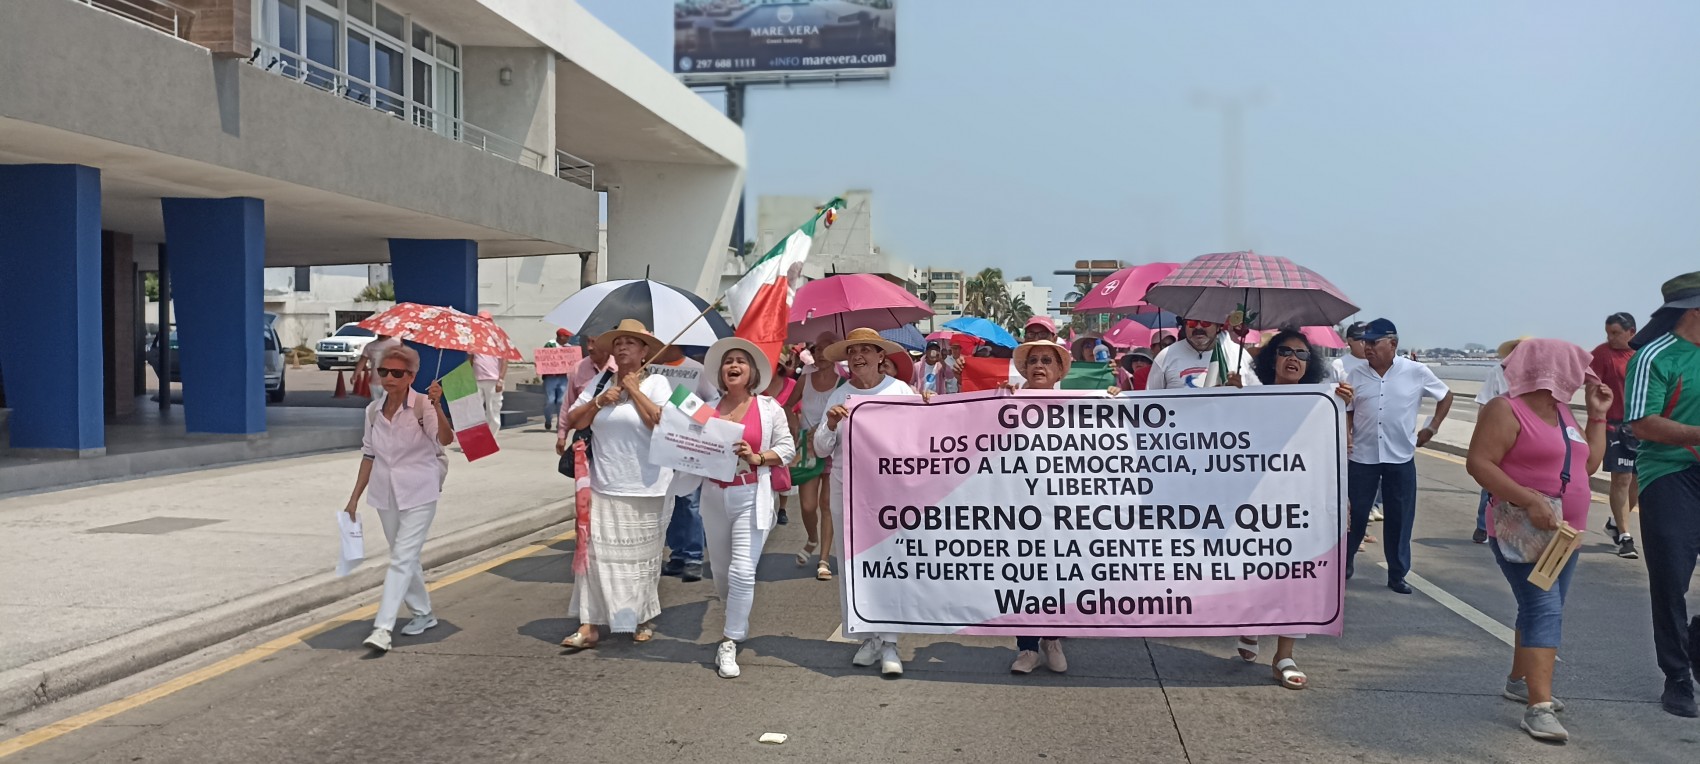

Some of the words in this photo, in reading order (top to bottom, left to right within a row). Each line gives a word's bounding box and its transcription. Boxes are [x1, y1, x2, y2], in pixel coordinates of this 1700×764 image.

[750, 27, 784, 37] MARE
[788, 25, 819, 36] VERA
[696, 59, 712, 69] 297
[734, 58, 756, 68] 1111
[802, 54, 887, 66] marevera.com
[998, 404, 1175, 428] GOBIERNO:
[930, 436, 968, 453] LOS
[975, 434, 1128, 451] CIUDADANOS
[1137, 432, 1250, 450] EXIGIMOS
[879, 457, 970, 475] RESPETO
[978, 457, 993, 474] A
[1001, 457, 1028, 473] LA
[1037, 455, 1196, 475] DEMOCRACIA,
[1205, 454, 1306, 472] JUSTICIA
[1025, 478, 1038, 495] Y
[1047, 478, 1153, 495] LIBERTAD
[878, 505, 1041, 530] GOBIERNO
[1054, 505, 1224, 530] RECUERDA
[1235, 504, 1308, 532] QUE:
[896, 539, 928, 556] “EL
[936, 539, 1010, 557] PODER
[1018, 540, 1046, 557] DE
[1054, 540, 1081, 557] LA
[1089, 539, 1162, 557] GENTE
[1171, 539, 1195, 556] ES
[1204, 538, 1292, 556] MUCHO
[863, 557, 909, 579] MÁS
[916, 563, 994, 580] FUERTE
[1002, 563, 1048, 583] QUE
[1057, 564, 1084, 580] LA
[1092, 563, 1165, 581] GENTE
[1174, 563, 1202, 580] EN
[1212, 563, 1235, 580] EL
[1243, 561, 1327, 580] PODER”
[995, 588, 1065, 614] Wael
[1077, 589, 1192, 615] Ghomin
